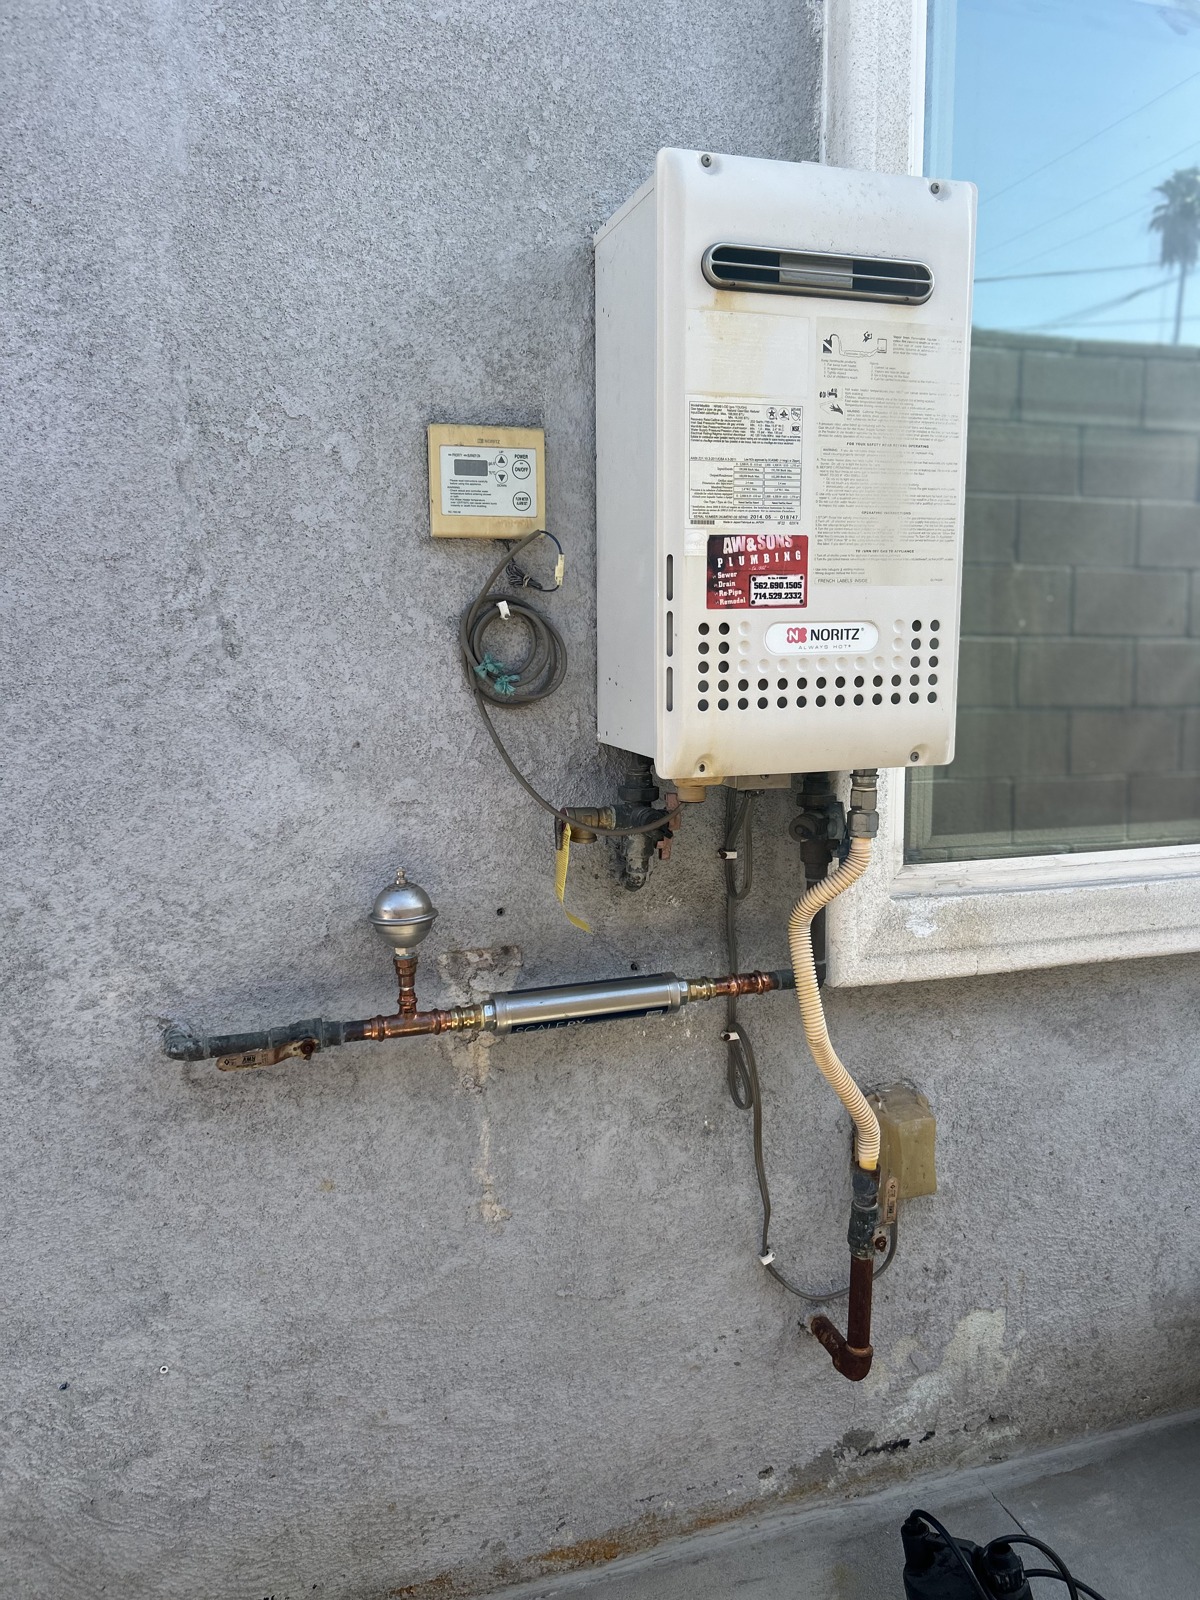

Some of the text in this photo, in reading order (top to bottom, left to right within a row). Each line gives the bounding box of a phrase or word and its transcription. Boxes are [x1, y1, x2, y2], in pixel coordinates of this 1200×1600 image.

[717, 550, 801, 568] PLUMBING
[719, 597, 746, 605] Remodel
[810, 628, 860, 641] NORITZ
